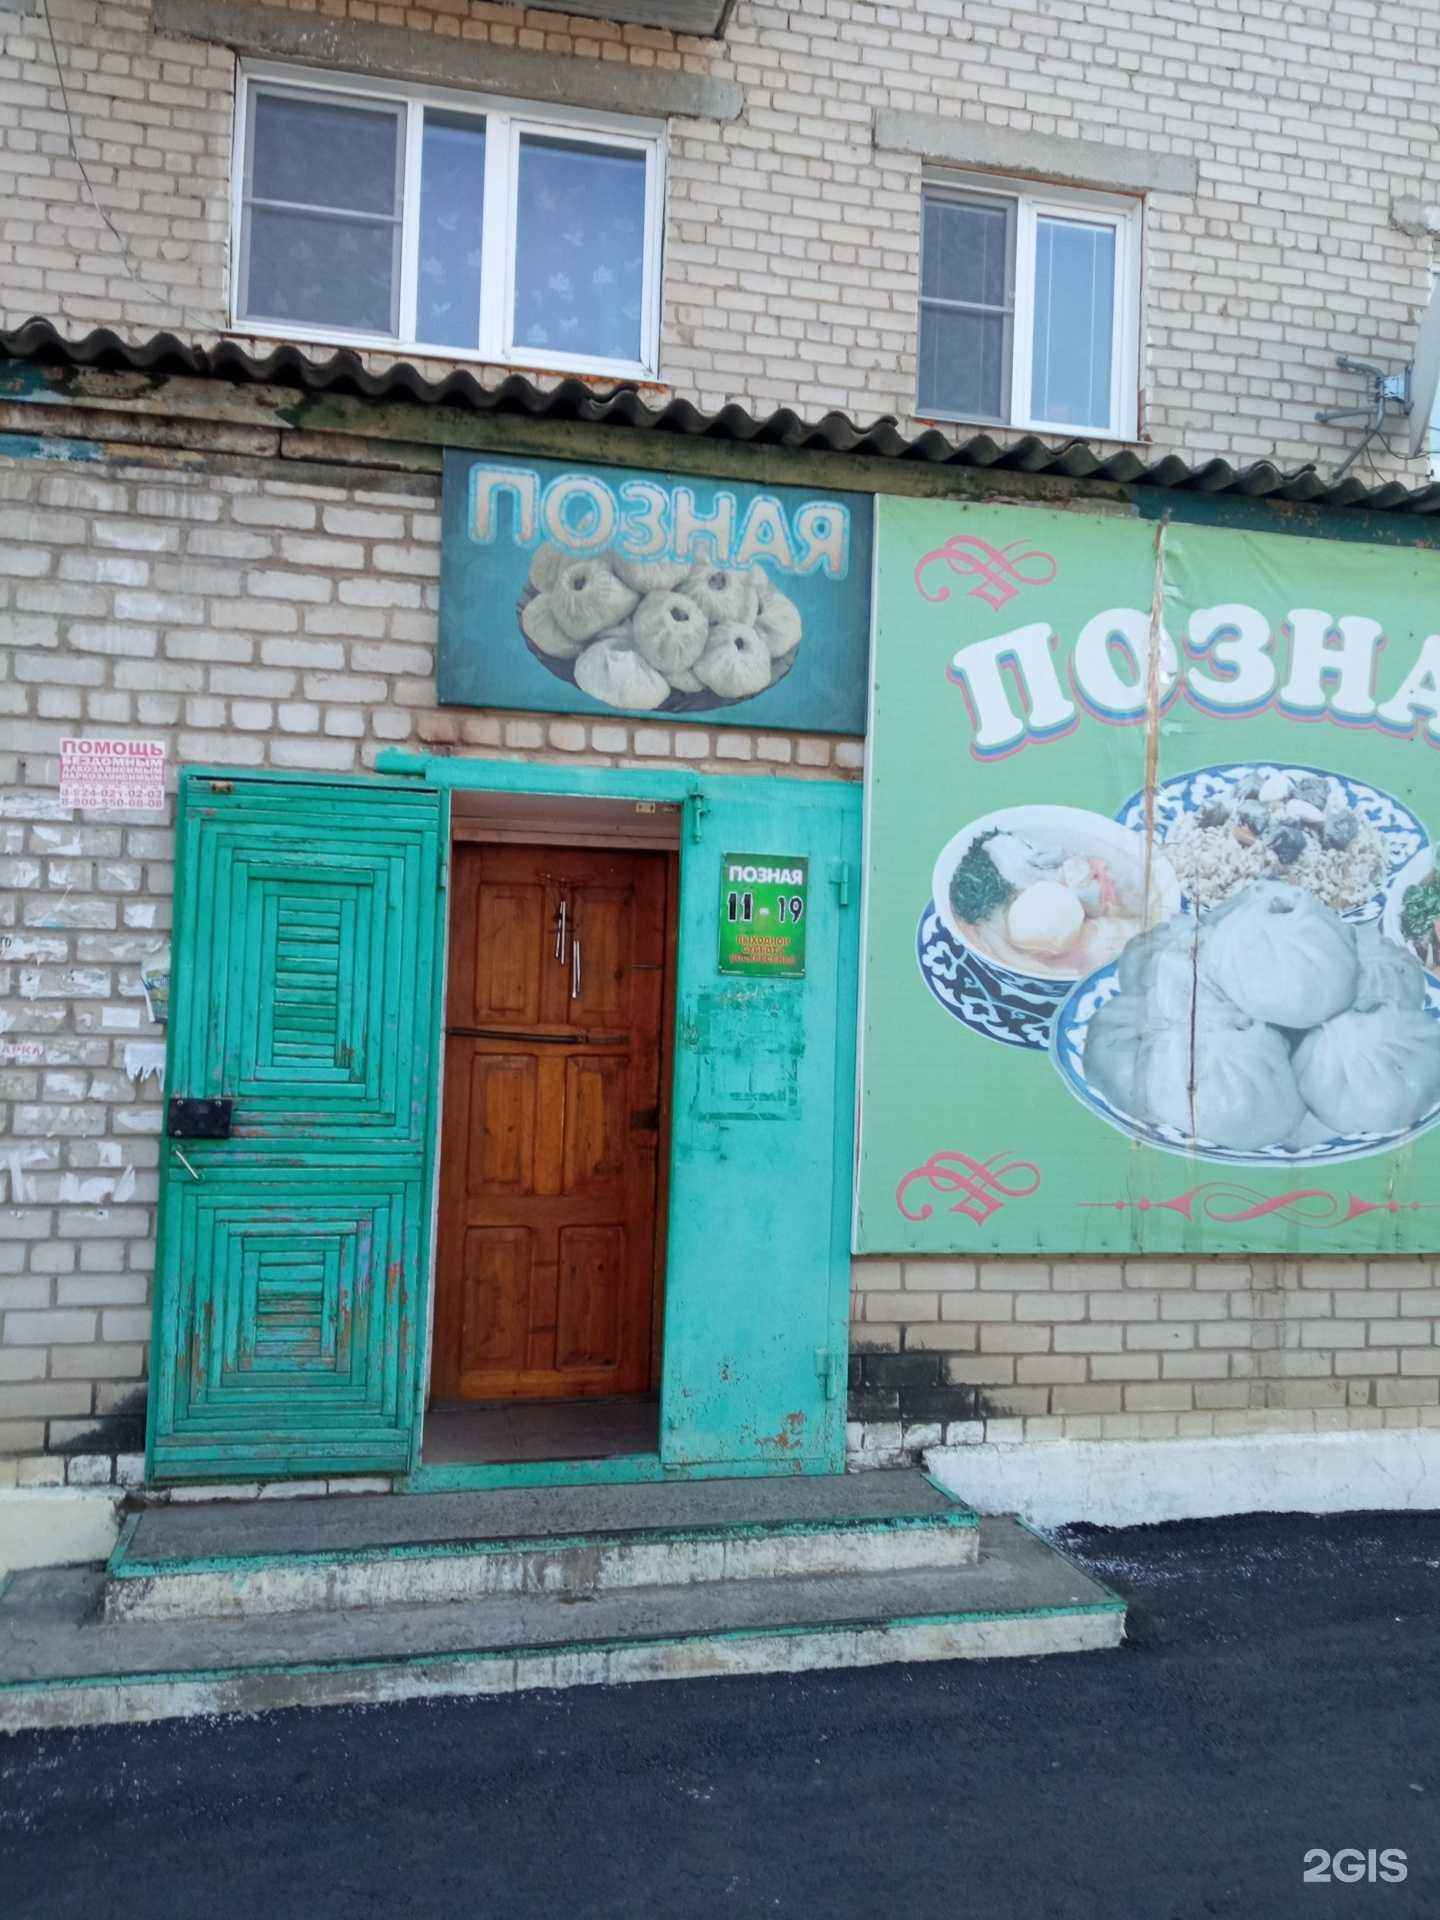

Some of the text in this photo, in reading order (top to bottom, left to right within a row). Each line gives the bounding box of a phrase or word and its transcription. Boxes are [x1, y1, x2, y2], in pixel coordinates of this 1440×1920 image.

[468, 462, 851, 580] ПОЗНАЯ
[61, 740, 164, 756] ПОМОЩЬ
[728, 865, 803, 886] ПОЗНАЯ
[727, 891, 754, 922] 11
[776, 895, 804, 924] 19
